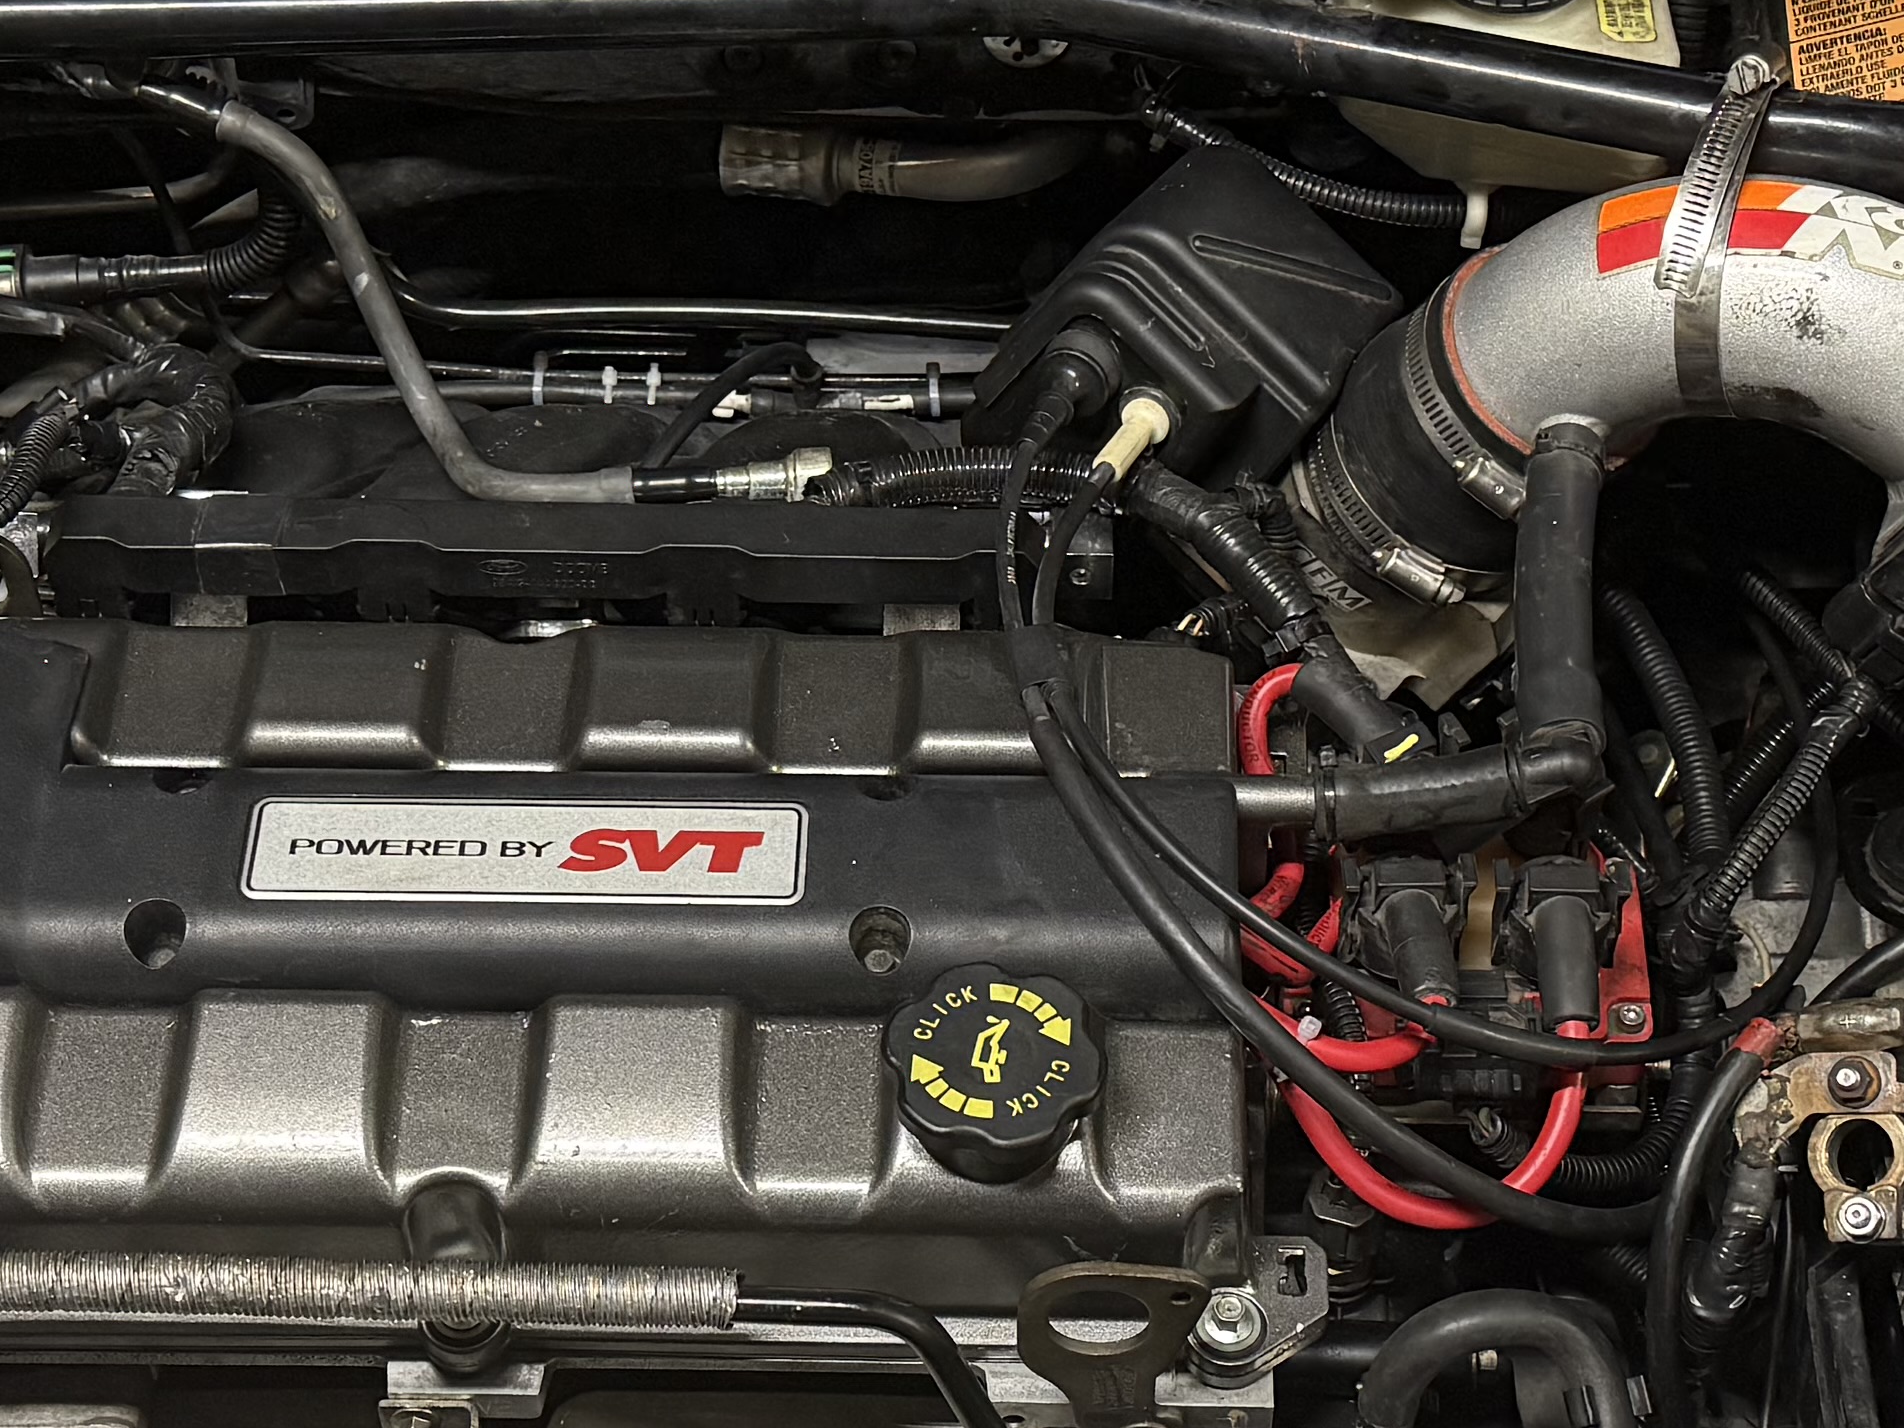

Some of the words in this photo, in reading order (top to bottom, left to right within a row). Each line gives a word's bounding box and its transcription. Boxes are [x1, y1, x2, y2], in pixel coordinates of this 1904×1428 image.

[1793, 0, 1834, 17] LIQUIDE
[1795, 18, 1800, 26] 3
[1804, 2, 1866, 23] PROVENANT
[1795, 15, 1857, 36] CONTENANT
[1838, 47, 1851, 56] EL
[1891, 33, 1904, 43] DE
[1800, 57, 1855, 76] LLENANDO
[1859, 47, 1894, 63] ANTES
[1801, 66, 1863, 87] EXTRAERLO
[1867, 60, 1888, 71] USE
[1866, 82, 1886, 93] DOT
[1891, 80, 1897, 88] 3
[288, 838, 487, 857] POWERED
[500, 841, 555, 858] BY
[557, 828, 765, 873] SVT
[913, 985, 978, 1040] CLICK
[1006, 1060, 1070, 1117] CLICK
